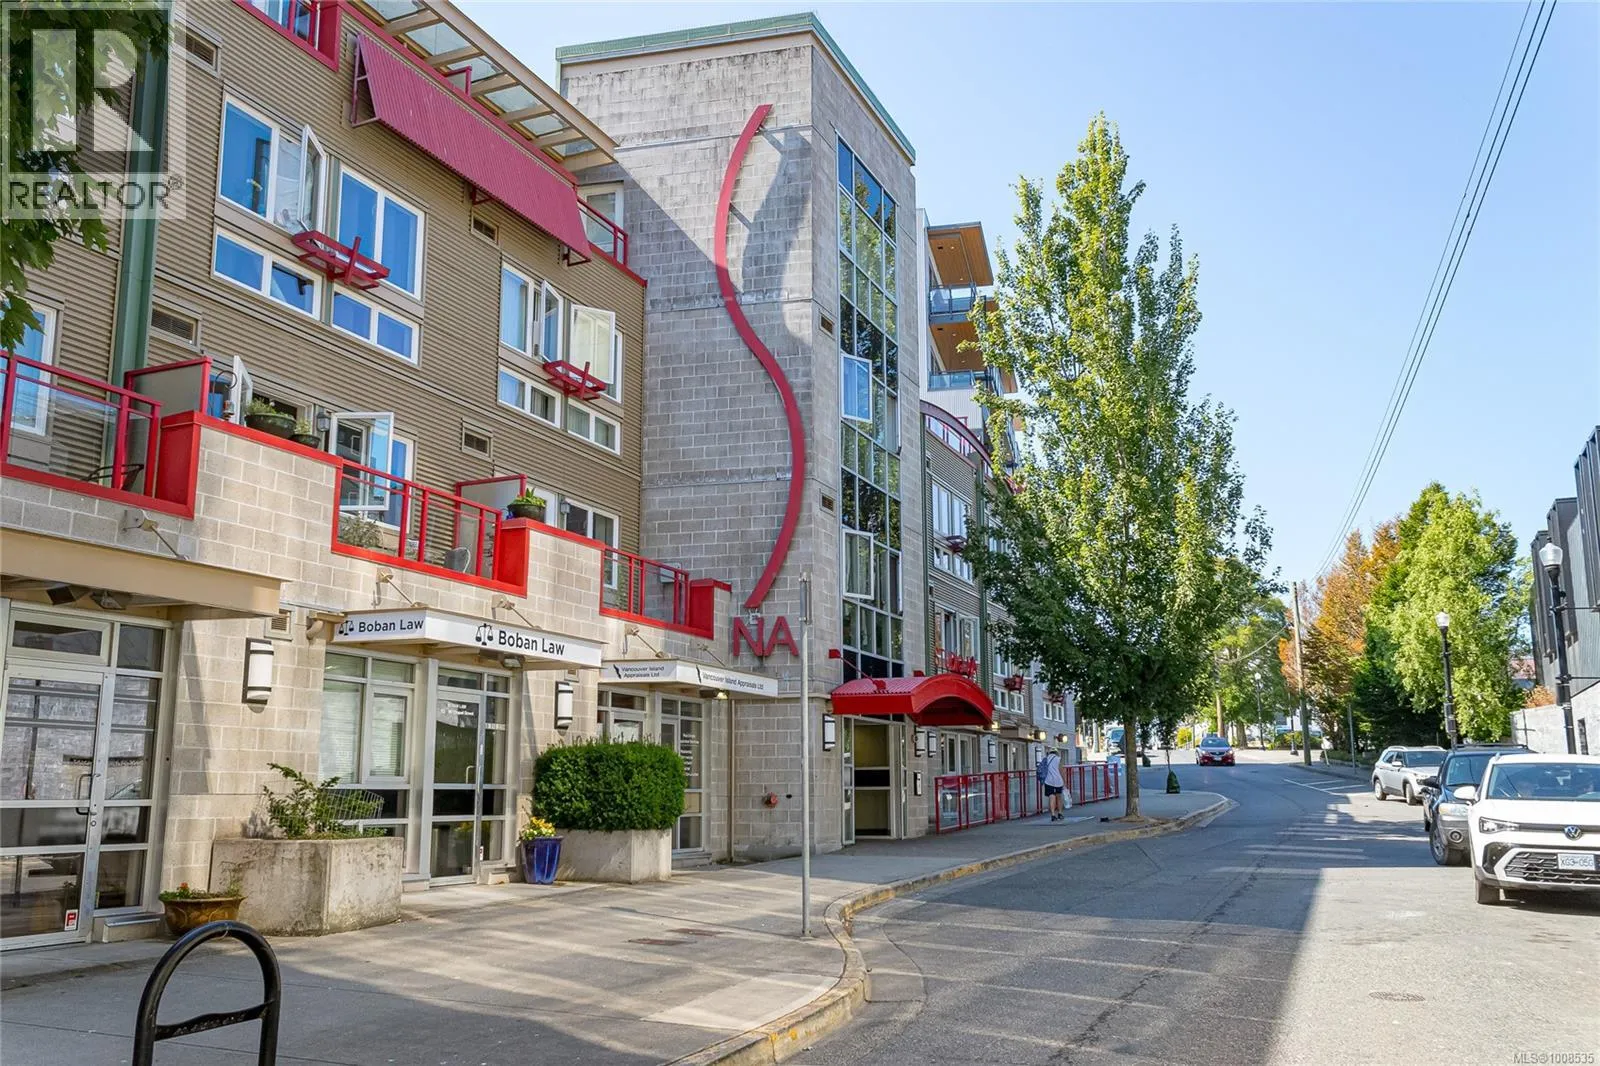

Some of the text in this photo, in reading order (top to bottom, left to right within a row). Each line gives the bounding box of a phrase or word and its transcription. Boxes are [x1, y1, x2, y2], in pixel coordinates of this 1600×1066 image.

[358, 619, 424, 633] Boban Law
[498, 630, 565, 656] Boban Law
[702, 671, 725, 682] Vancouver
[725, 676, 737, 686] Island
